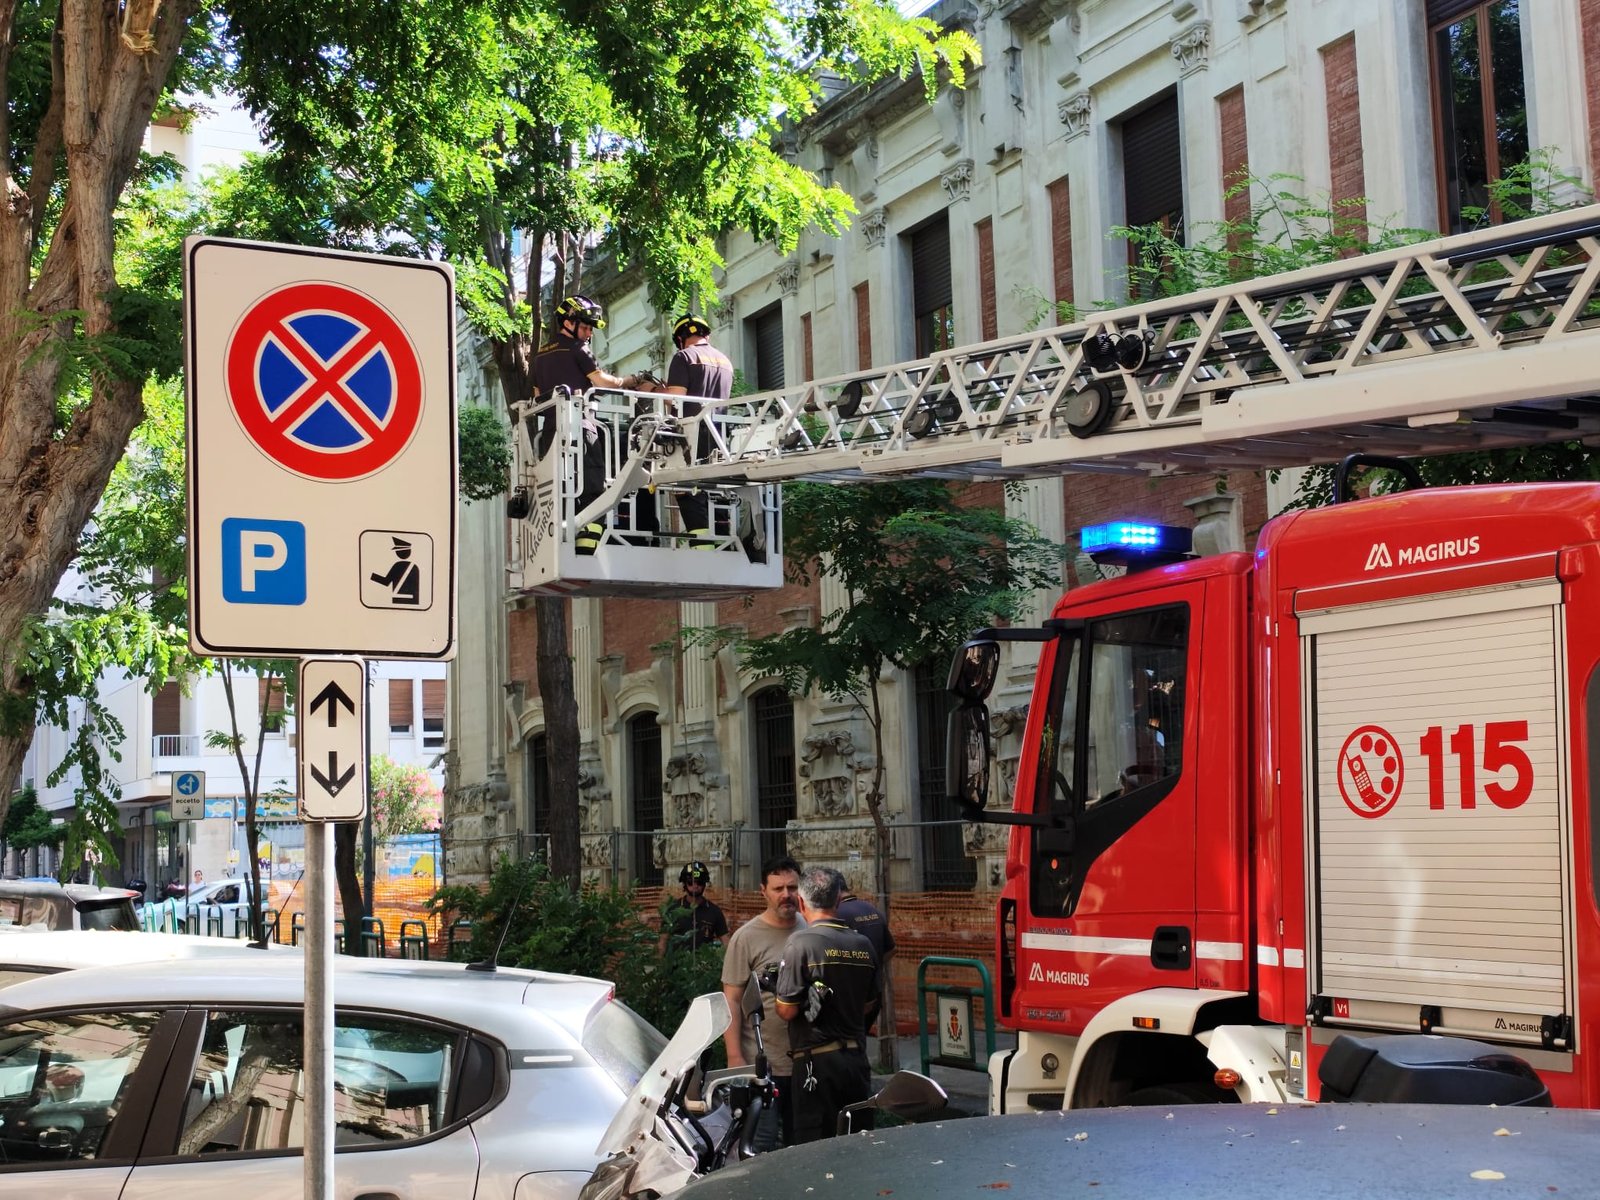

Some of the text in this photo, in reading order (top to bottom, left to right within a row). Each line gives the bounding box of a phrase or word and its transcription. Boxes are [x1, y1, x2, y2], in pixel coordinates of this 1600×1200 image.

[528, 499, 555, 563] MAGIRUS
[240, 530, 288, 592] P
[1398, 535, 1480, 566] MAGIRUS
[1420, 720, 1534, 810] 115
[842, 950, 852, 958] DEL
[1046, 969, 1090, 987] MAGIRUS
[1336, 1003, 1348, 1014] V1
